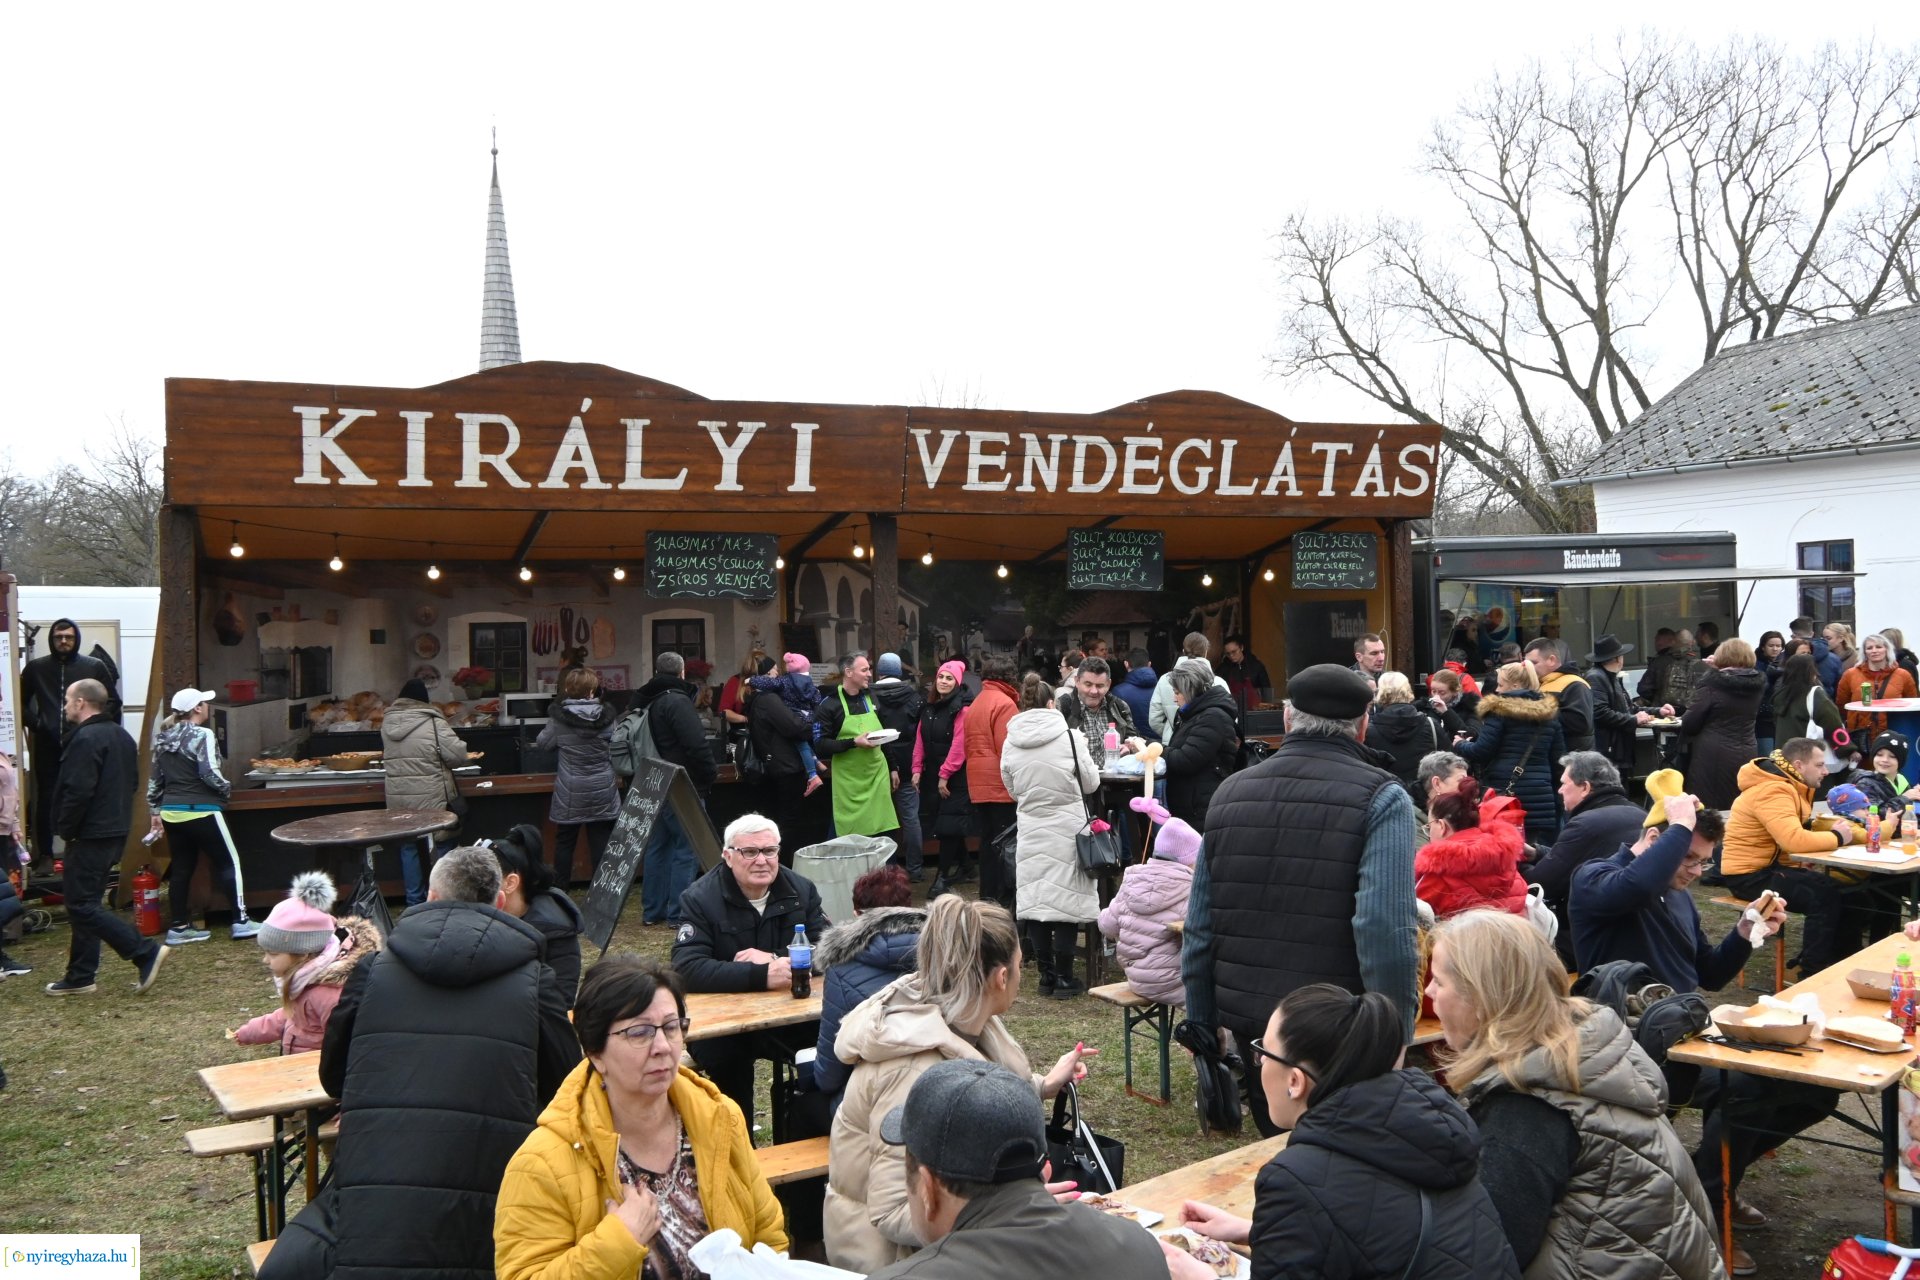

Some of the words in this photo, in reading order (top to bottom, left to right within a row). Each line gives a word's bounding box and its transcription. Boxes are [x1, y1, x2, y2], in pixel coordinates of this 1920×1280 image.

[293, 398, 819, 492] KIRÁLYI
[910, 422, 1435, 497] VENDÉGLÁTÁS
[654, 536, 715, 551] HAGYMÁS
[1073, 531, 1103, 546] SÜLT
[1073, 547, 1101, 561] SÜLT
[1105, 546, 1144, 557] HURKA
[1071, 561, 1097, 573] SÜLT
[1100, 558, 1142, 569] OLDALAS
[657, 571, 708, 588] ZSÍROS
[715, 571, 773, 589] KENYÉR
